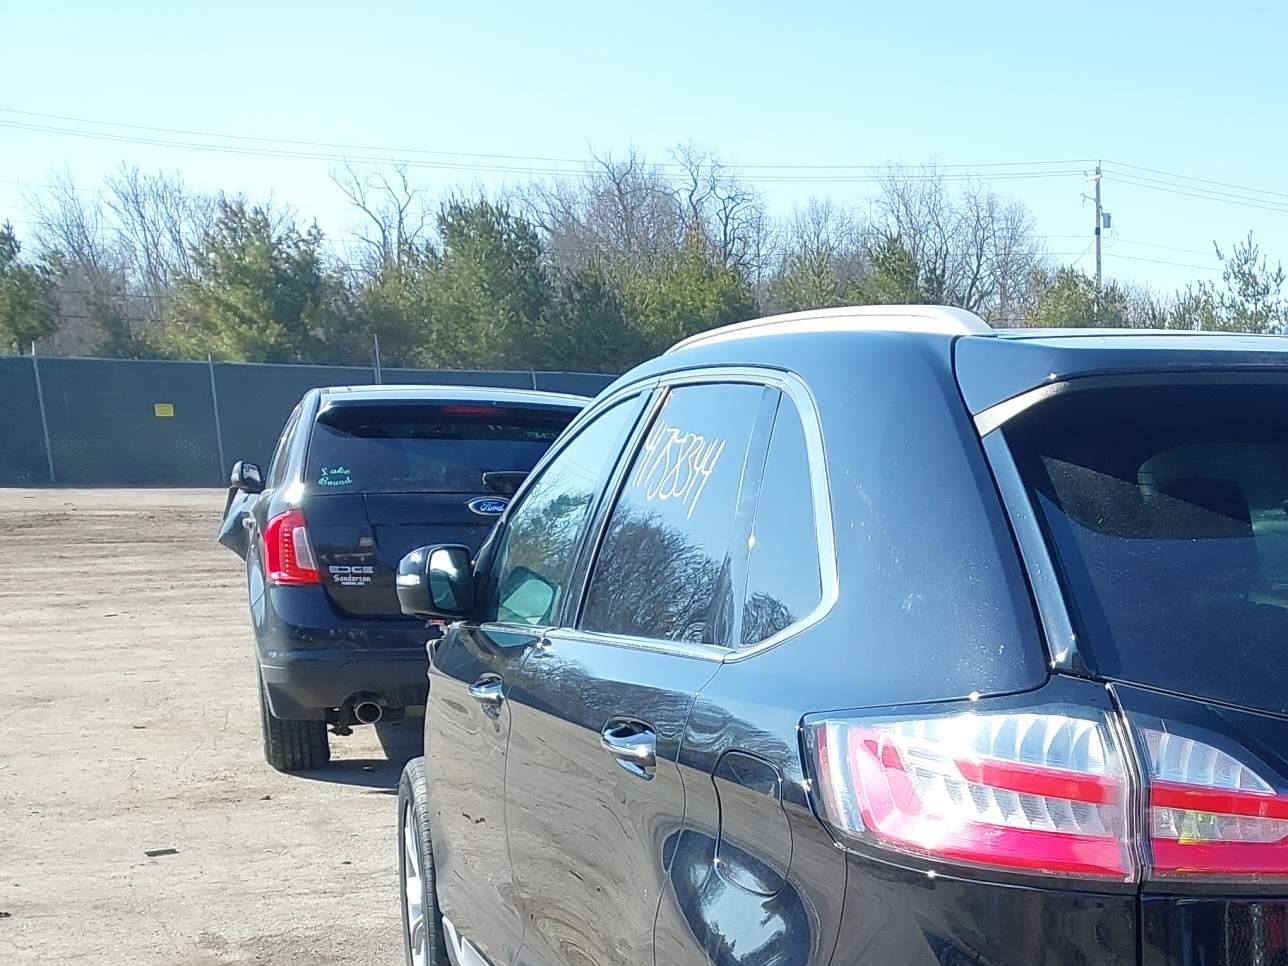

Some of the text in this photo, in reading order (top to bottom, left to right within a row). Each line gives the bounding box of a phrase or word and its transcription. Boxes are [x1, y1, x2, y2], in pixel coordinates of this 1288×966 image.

[320, 466, 350, 476] Lake
[318, 476, 352, 486] Bound
[480, 501, 504, 512] Ford
[328, 565, 374, 574] EDGE
[333, 574, 371, 582] Sanderson
